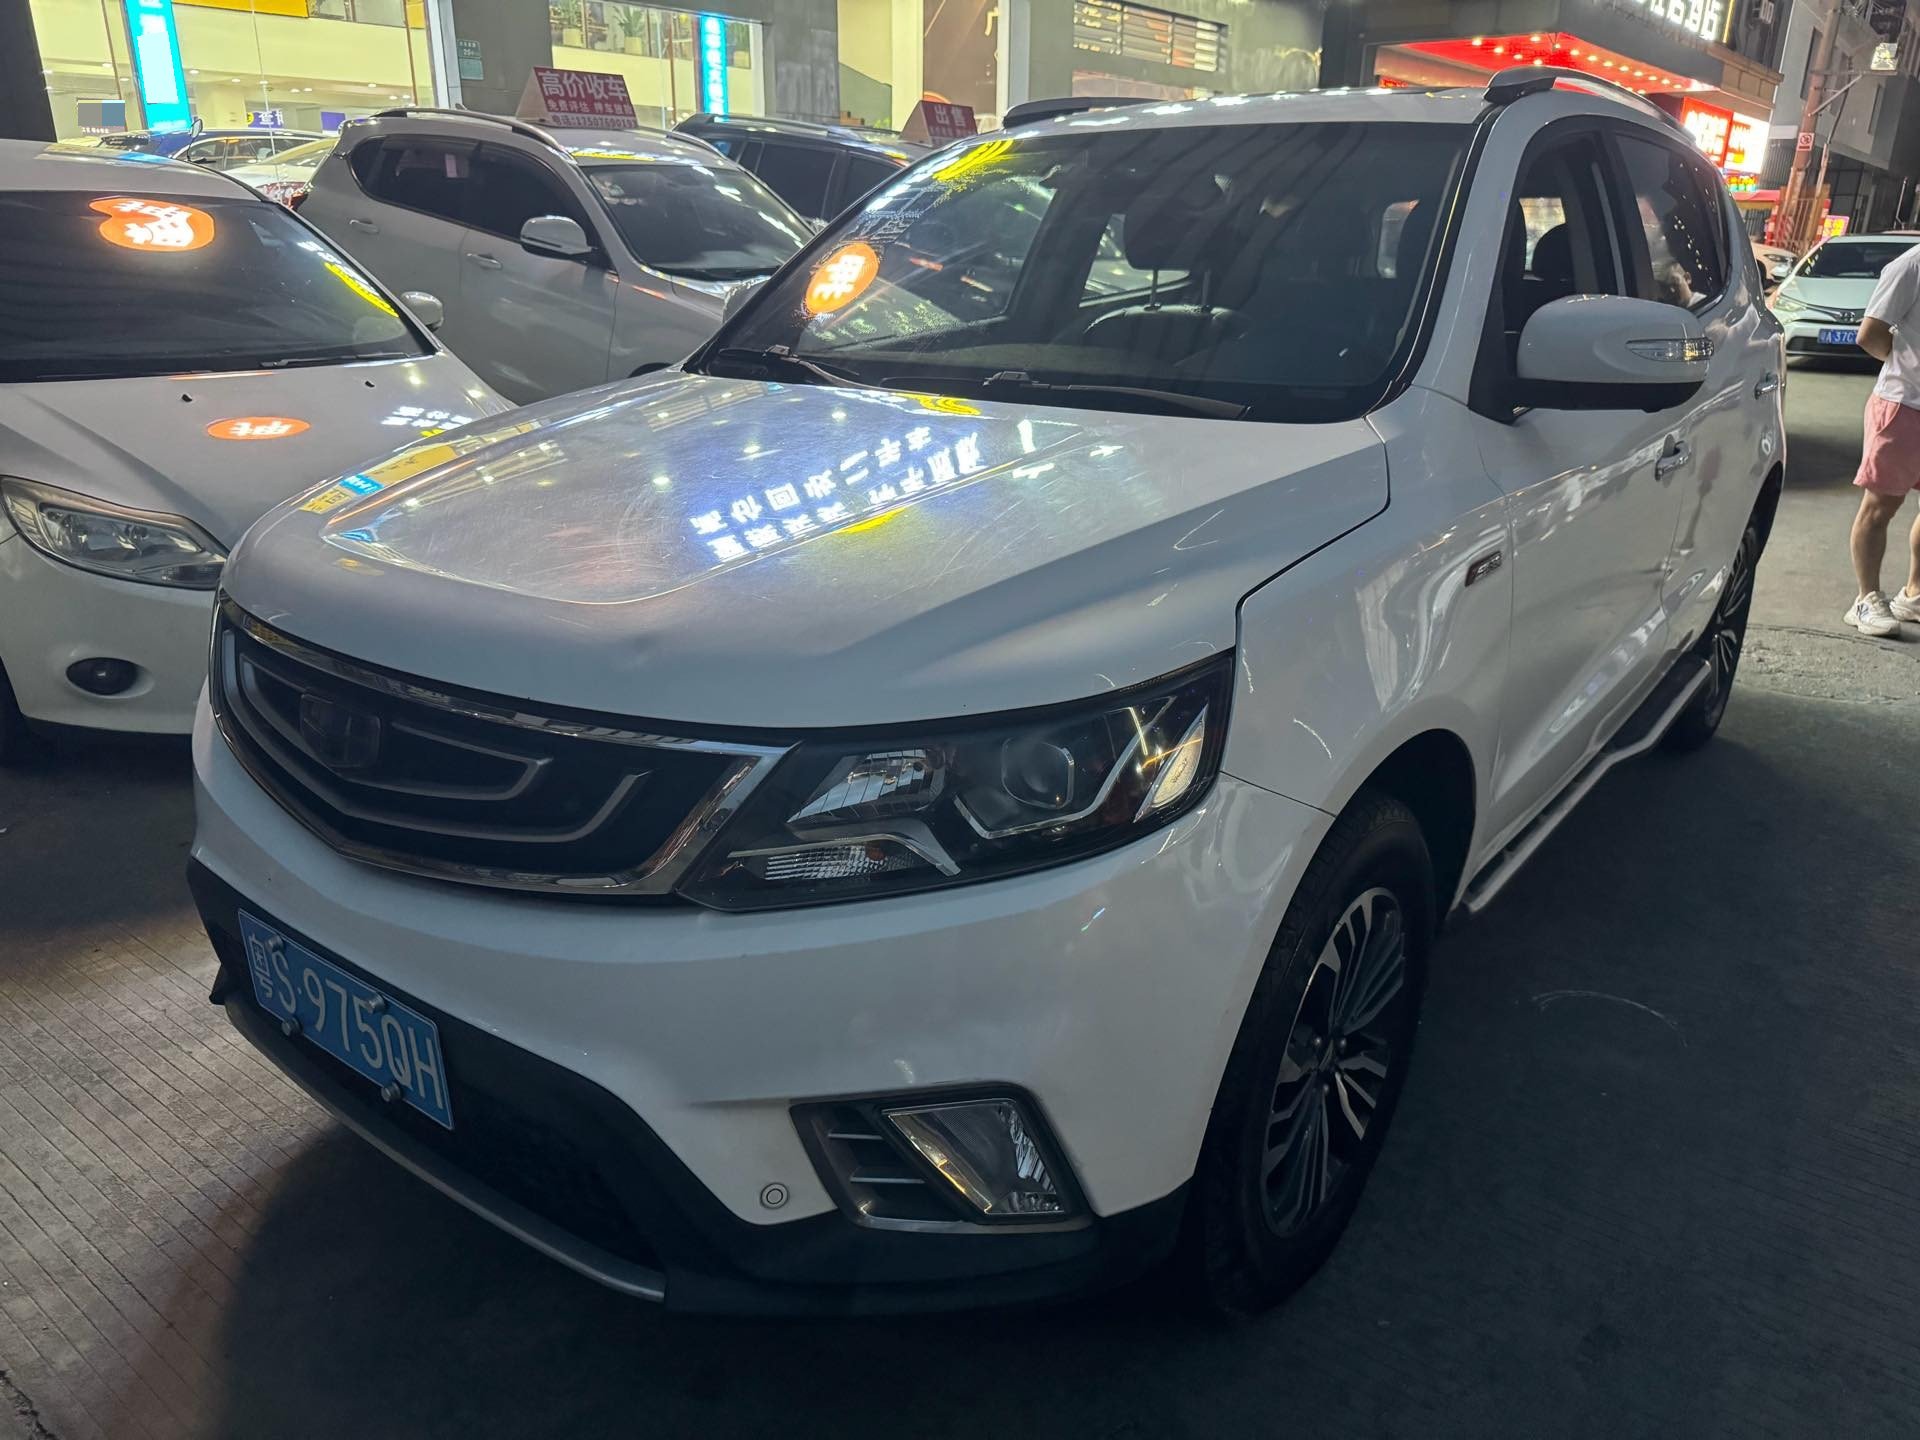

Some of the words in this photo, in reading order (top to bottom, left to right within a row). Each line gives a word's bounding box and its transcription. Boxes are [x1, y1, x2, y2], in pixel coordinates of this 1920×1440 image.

[537, 70, 628, 101] 高价收车
[934, 104, 966, 127] 出售
